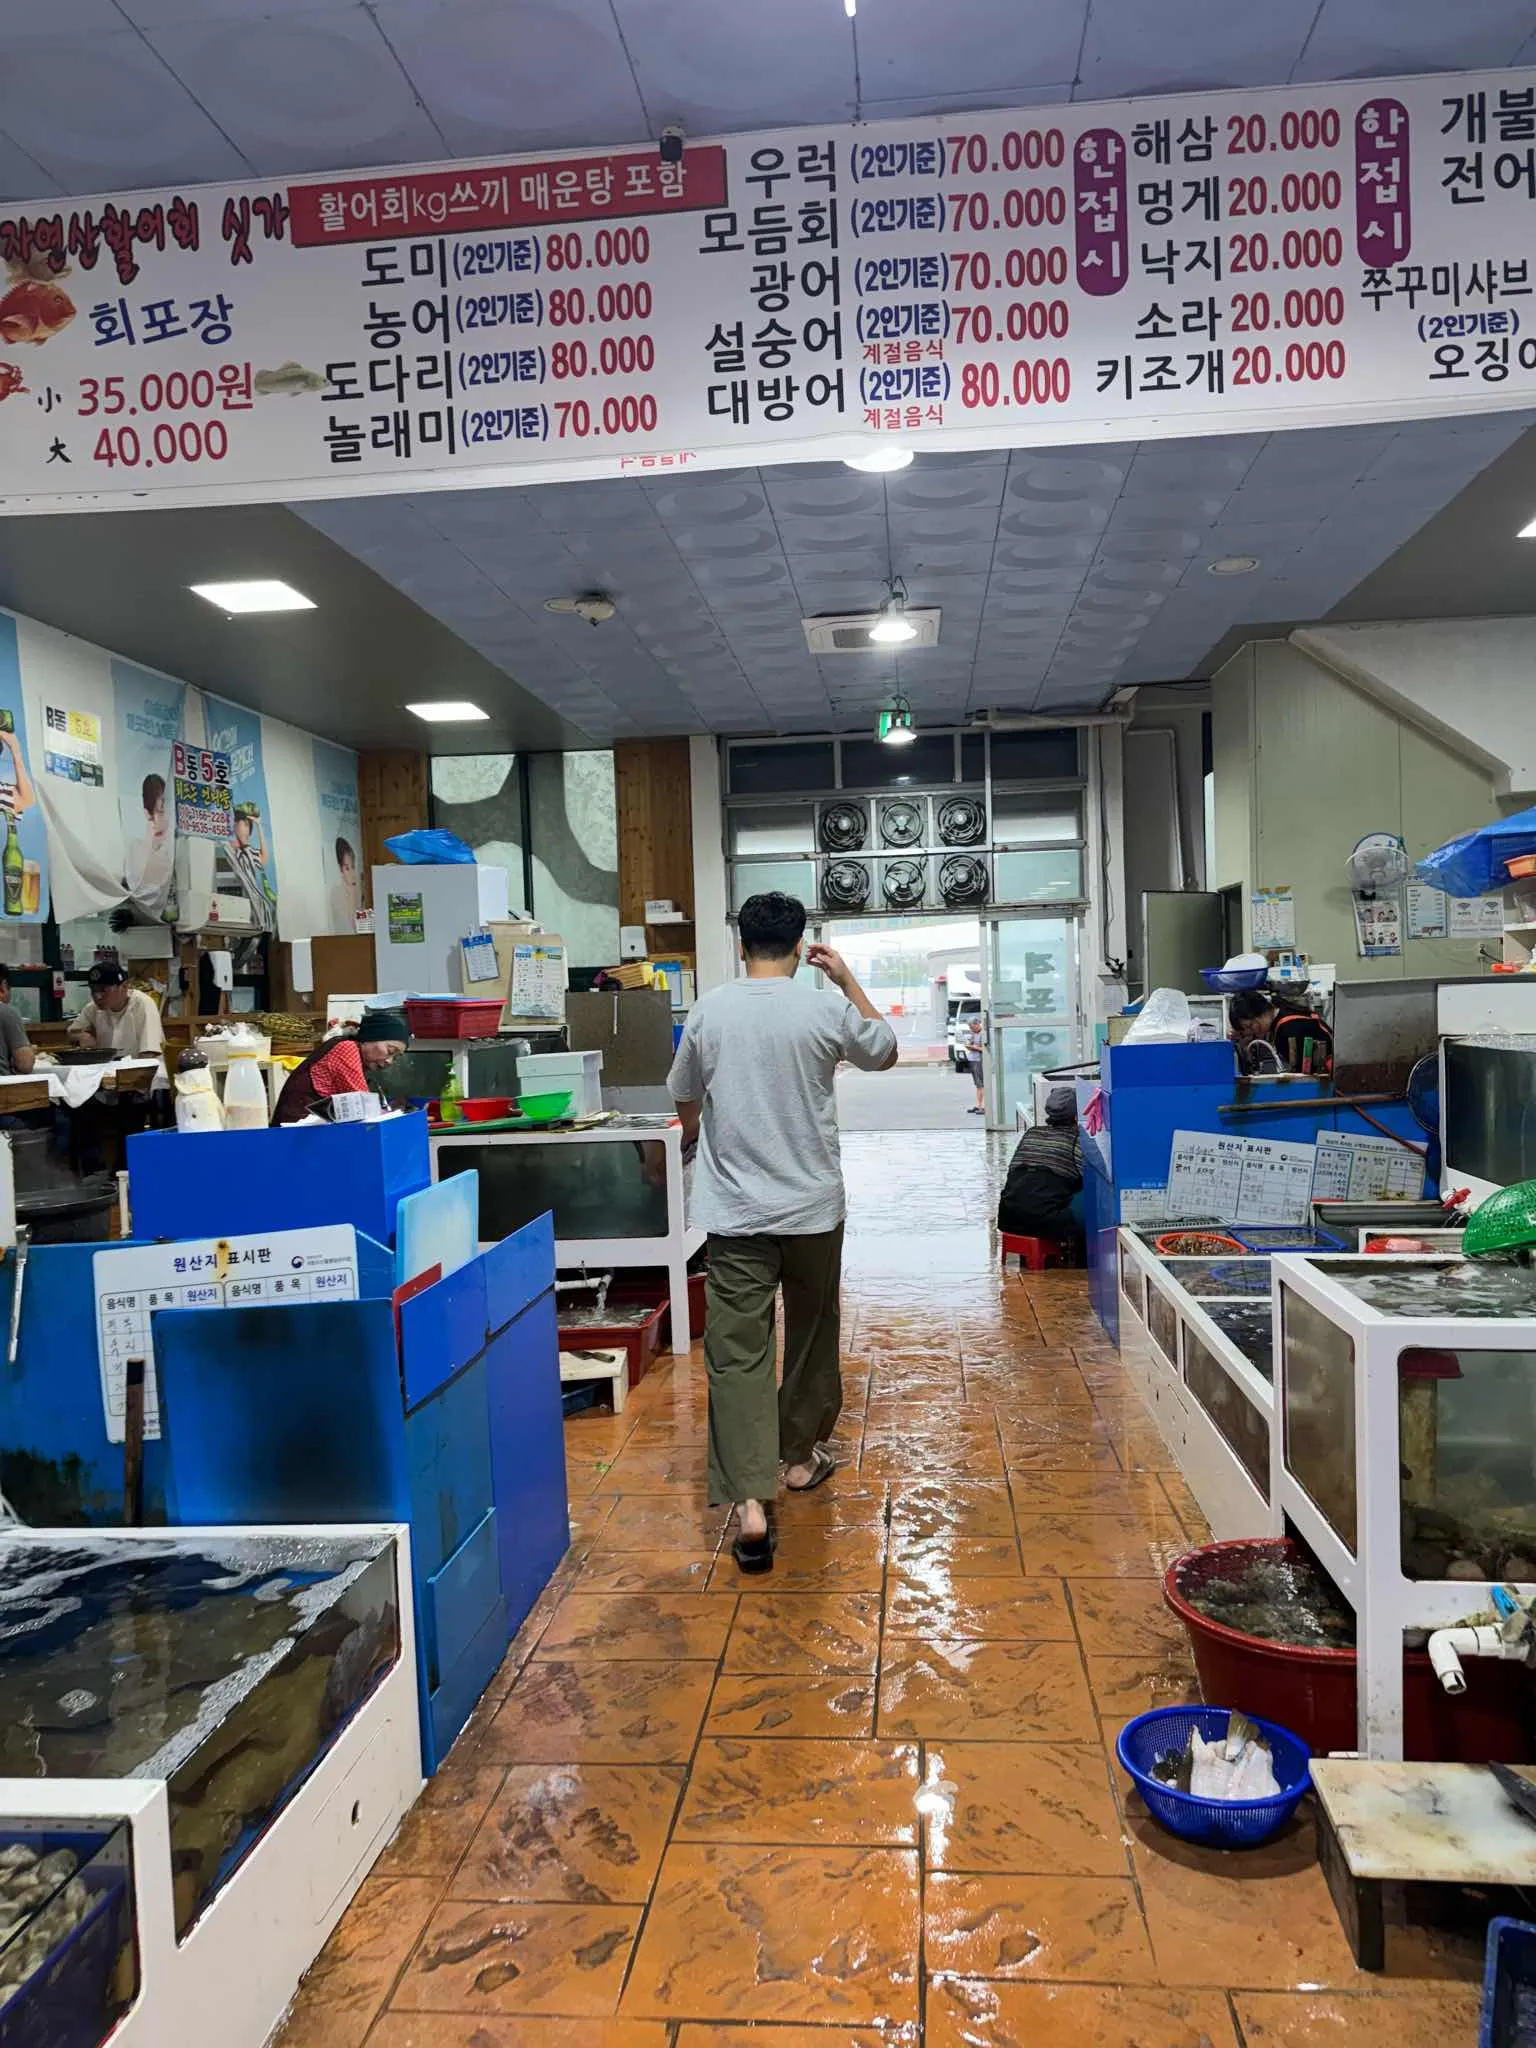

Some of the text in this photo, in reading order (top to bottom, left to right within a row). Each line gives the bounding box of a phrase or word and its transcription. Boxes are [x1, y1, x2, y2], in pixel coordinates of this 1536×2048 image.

[1131, 107, 1341, 165] 해삼 20.000
[1440, 87, 1536, 144] 개불
[745, 128, 1065, 199] 우럭 (2인기준) 70.000
[1359, 107, 1405, 249] 한접시
[1441, 148, 1535, 205] 전어
[317, 158, 688, 232] 활어회kg쓰끼 매운탕 포함
[698, 186, 1067, 255] 모듬회 (2인기준) 70.000
[1077, 136, 1122, 278] 한접시
[1138, 170, 1342, 226] 멍게 20.000
[222, 193, 289, 265] 싯가
[361, 225, 650, 287] 도미 (2인기준) 80.000
[1140, 227, 1343, 285] 낙지 20.000
[749, 246, 1068, 313] 광어 (2인기준) 70.000
[1360, 259, 1533, 311] 쭈꾸미샤브
[88, 294, 234, 346] 회포장
[362, 281, 652, 349] 농어 (2인기준) 80.000
[705, 300, 1069, 373] 설숭어 (2인기준) 70.000
[1135, 286, 1345, 342] 소라 20.000
[1418, 308, 1520, 342] (2인기준)
[320, 334, 655, 403] 도다리 (2인기준) 80.000
[862, 339, 944, 365] 계절음식
[1096, 339, 1346, 400] 키조개 20.000
[37, 361, 254, 417] 小 35.000원
[707, 358, 1071, 425] 대방어 (2인기준) 80.000
[863, 404, 944, 430] 계절음식
[45, 419, 229, 468] 大 40.000
[323, 393, 657, 463] 놀래미 (2인기준) 70.000
[173, 1247, 271, 1272] 원산지 표시판
[106, 1296, 136, 1310] 음식명
[187, 1287, 217, 1301] 원산지
[232, 1281, 262, 1297] 음식명
[316, 1273, 348, 1288] 원산지
